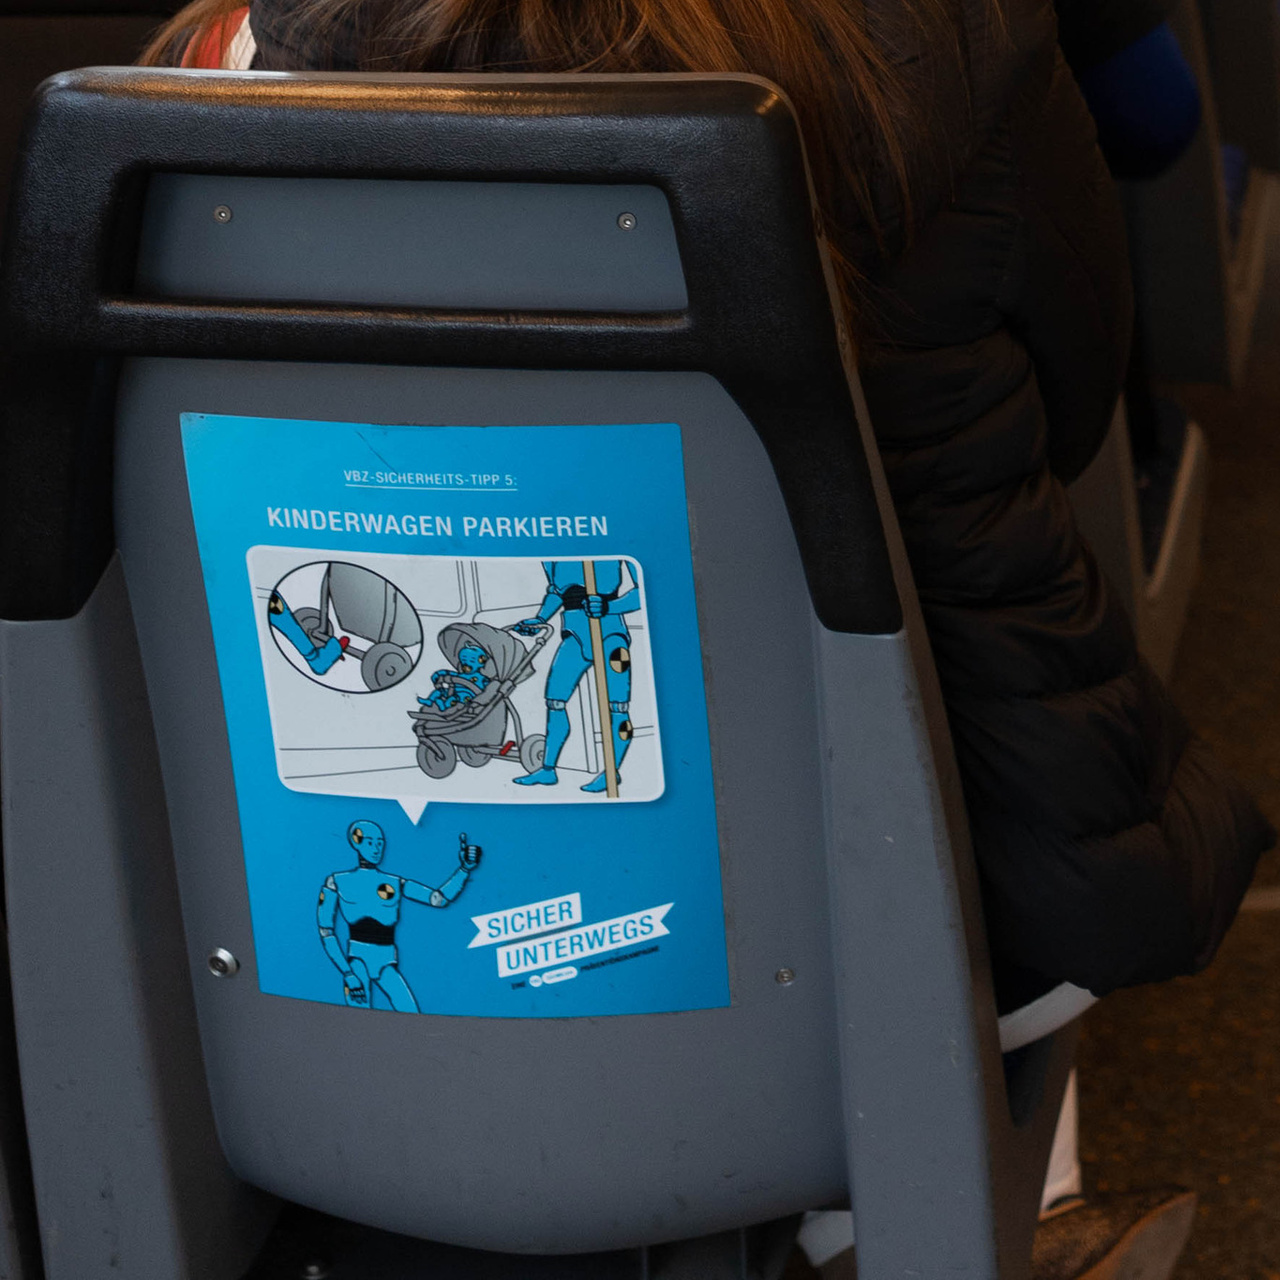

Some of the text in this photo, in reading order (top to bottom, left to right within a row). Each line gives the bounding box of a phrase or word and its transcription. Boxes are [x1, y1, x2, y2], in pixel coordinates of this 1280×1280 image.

[344, 470, 518, 486] VBZ-SICHERHEITS-TIPP 5:
[267, 506, 608, 537] KINDERWAGEN PARKIEREN
[487, 900, 573, 939] SICHER
[505, 914, 655, 970] UNTERWEGS
